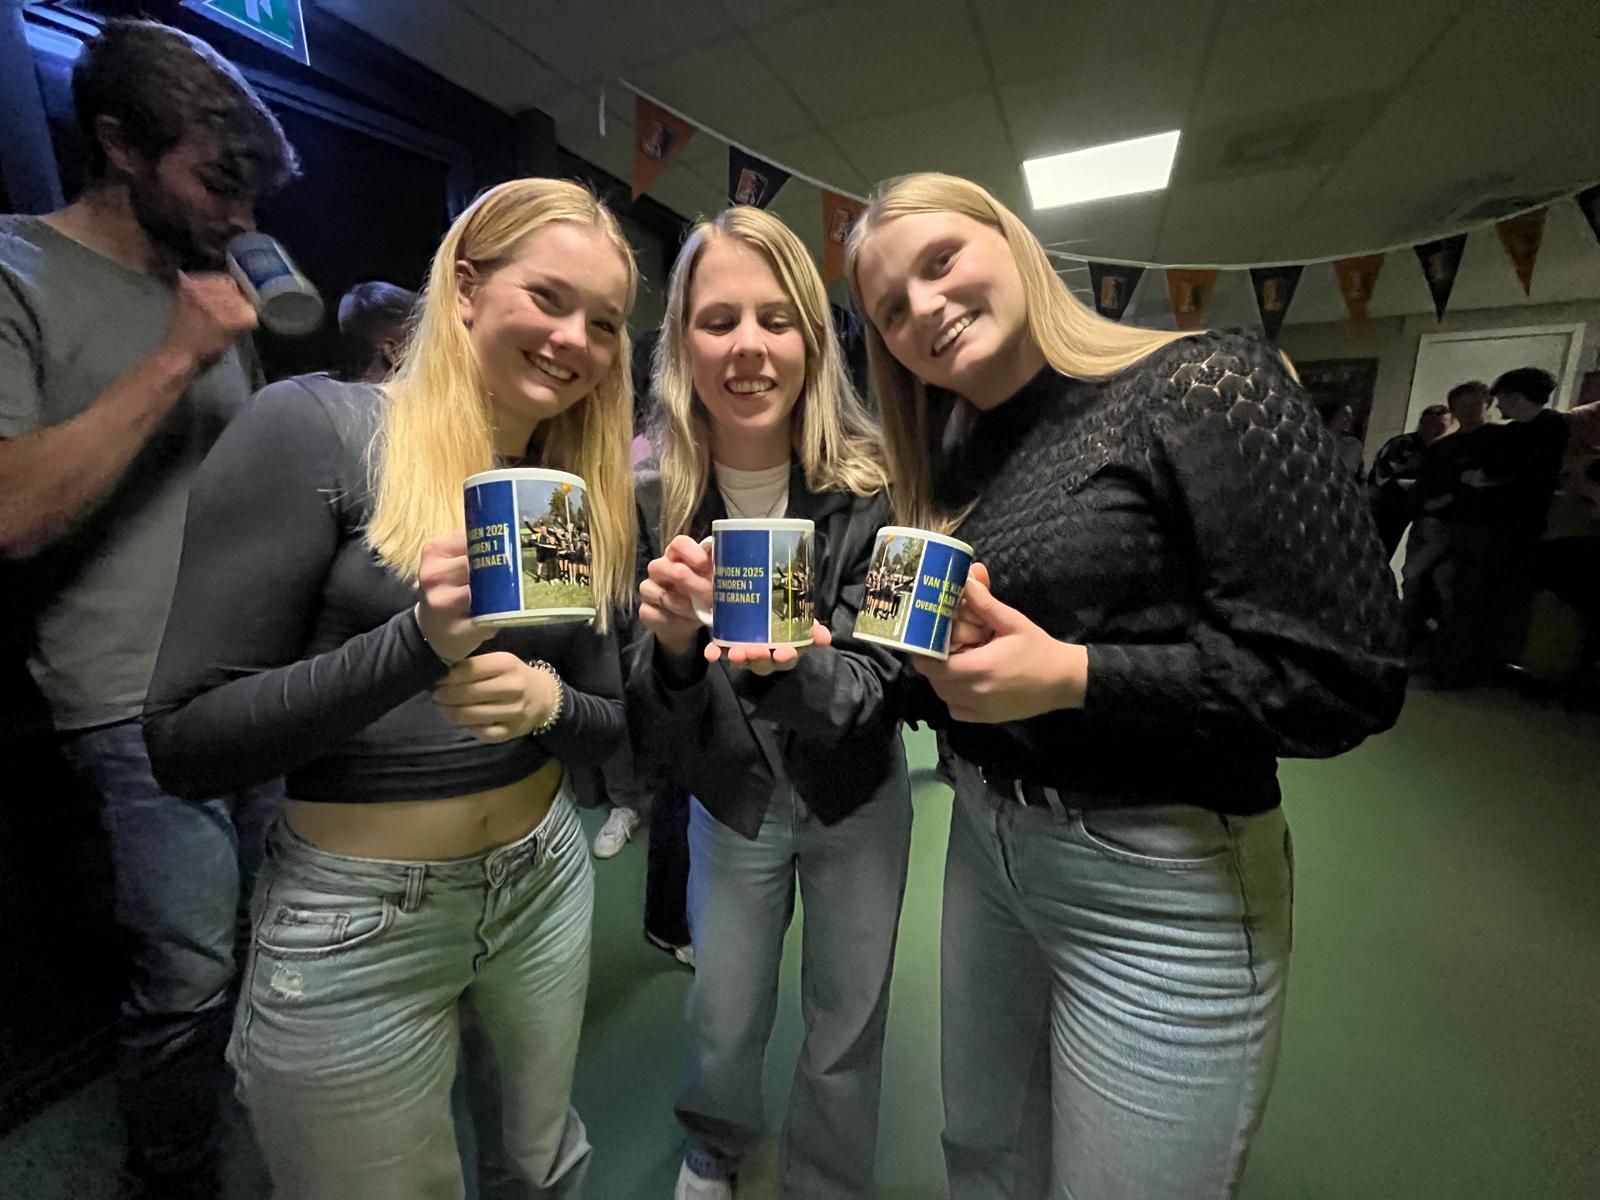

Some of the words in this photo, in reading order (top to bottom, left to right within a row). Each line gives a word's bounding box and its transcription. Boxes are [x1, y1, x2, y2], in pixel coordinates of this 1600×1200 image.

[742, 566, 765, 578] 2025
[748, 580, 753, 590] 1
[923, 574, 941, 589] VAN
